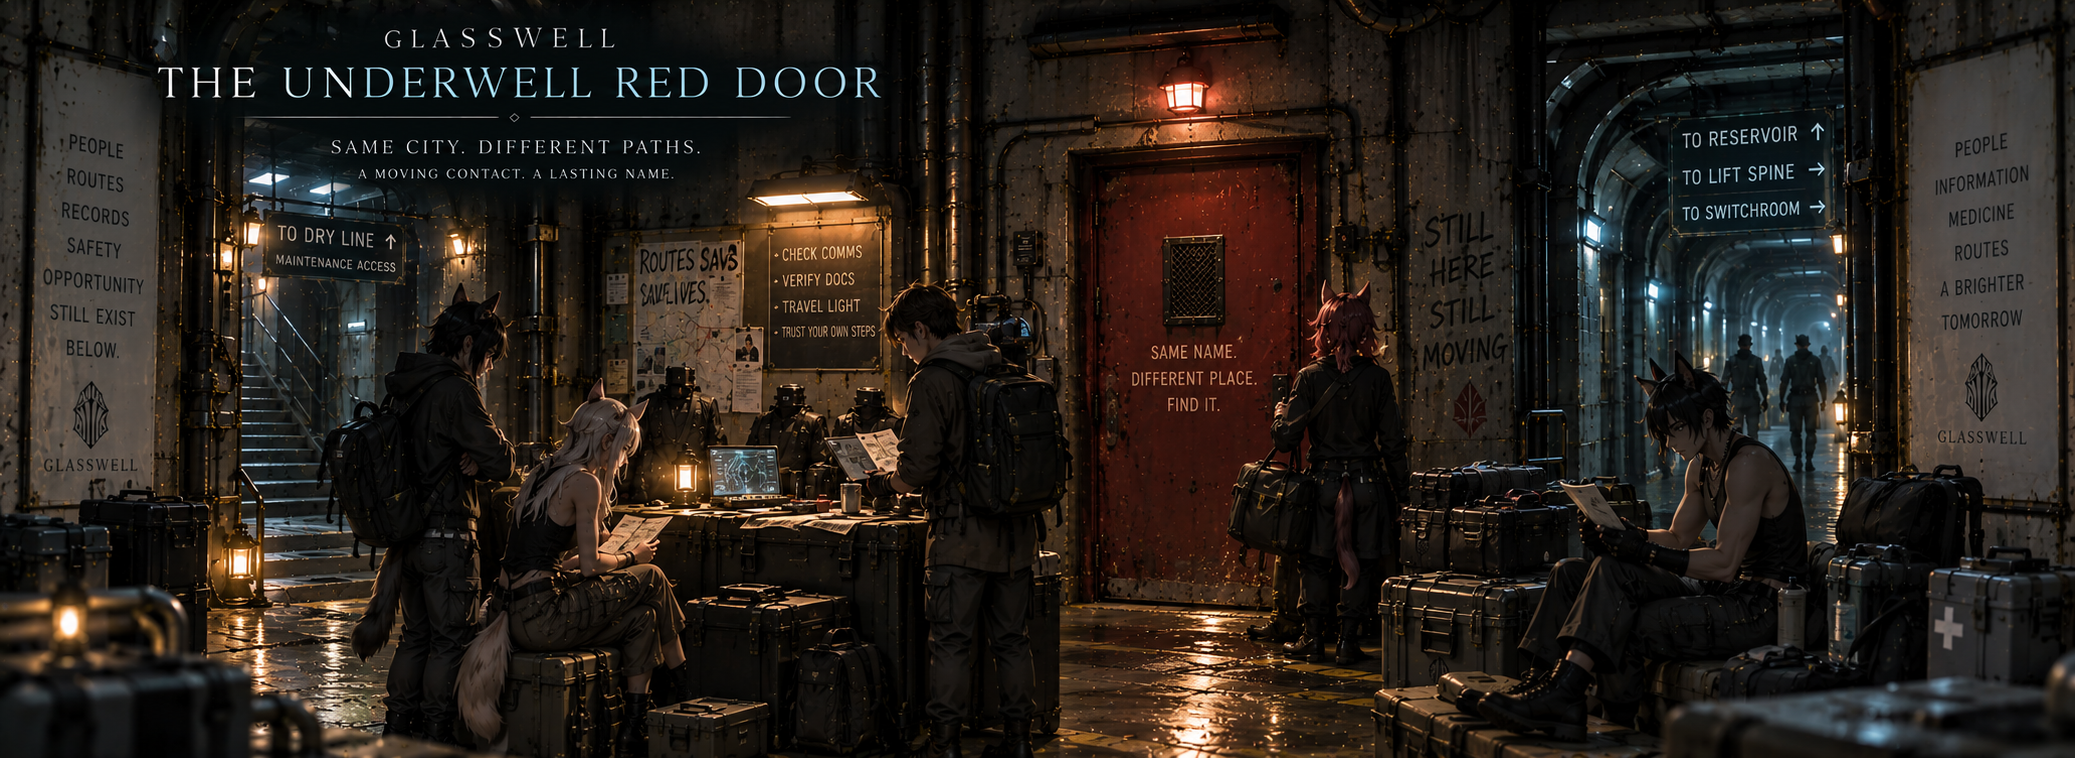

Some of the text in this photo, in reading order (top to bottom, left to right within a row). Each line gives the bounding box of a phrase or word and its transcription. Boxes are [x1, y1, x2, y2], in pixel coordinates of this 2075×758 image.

[69, 134, 124, 159] PEOPLE
[1682, 125, 1798, 149] TO RESERVOIR
[1955, 132, 2008, 158] PEOPLE
[67, 168, 124, 193] ROUTES
[1682, 163, 1795, 186] TO LIFT SPINE
[1935, 164, 2029, 196] INFORMATION
[62, 202, 130, 227] RECORDS
[1682, 200, 1800, 222] TO SWITCHROOM
[1949, 203, 2015, 228] MEDICINE
[277, 225, 374, 248] TO DRY LINE
[1424, 211, 1494, 248] STILL
[67, 237, 122, 259] SAFETY
[782, 244, 863, 262] CHECK COMMS
[1954, 239, 2009, 262] ROUTES
[275, 254, 396, 273] MAINTENANCE ACCESS
[640, 248, 695, 274] ROUTES
[1430, 251, 1494, 287] HERE
[43, 268, 144, 295] OPPORTUNITY
[782, 271, 855, 287] VERIFY DOCS
[1940, 273, 2025, 298] A BRIGHTER
[50, 304, 135, 327] STILL EXIST
[782, 298, 860, 313] TRAVEL LIGHT
[1430, 294, 1495, 330] STILL
[782, 325, 876, 338] TRUST YOUR OWN STEPS
[1941, 309, 2023, 331] TOMORROW
[66, 339, 120, 359] BELOW.
[1151, 344, 1237, 360] SAME NAME.
[1423, 332, 1508, 371] MOVING
[1131, 370, 1258, 386] DIFFERENT PLACE.
[1167, 397, 1220, 412] FIND IT.
[1937, 429, 2027, 445] GLASSWELL
[43, 458, 138, 473] GLASSWELL
